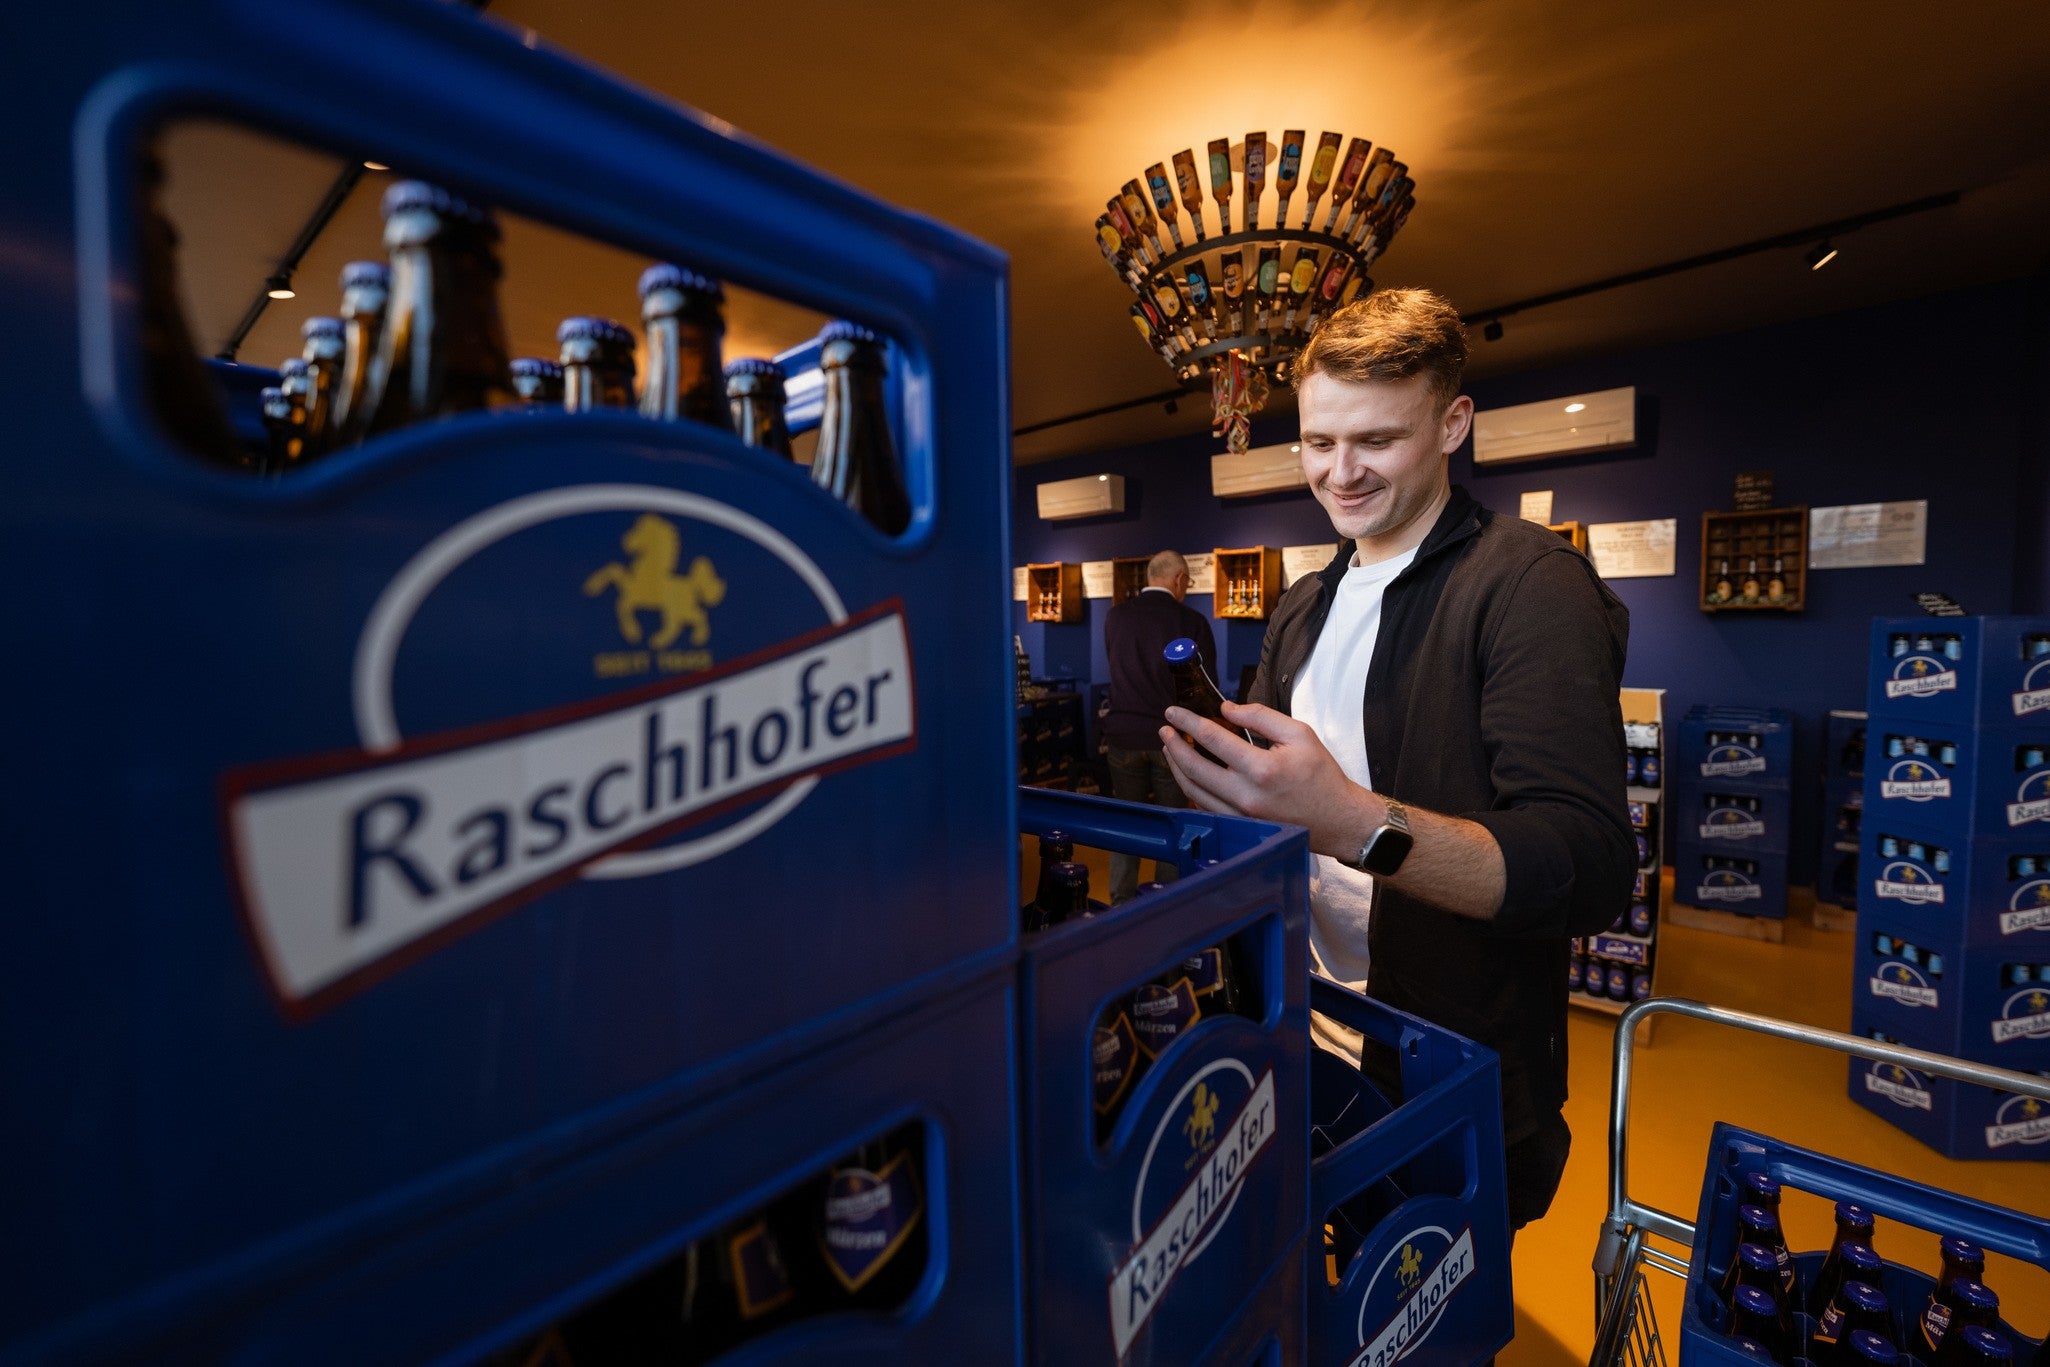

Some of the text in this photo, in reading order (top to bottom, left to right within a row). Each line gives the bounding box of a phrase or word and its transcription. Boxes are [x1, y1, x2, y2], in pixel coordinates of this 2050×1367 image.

[343, 658, 892, 930] Raschhofer
[1128, 1101, 1269, 1327] Raschhofer
[1357, 1249, 1468, 1367] aschhofer
